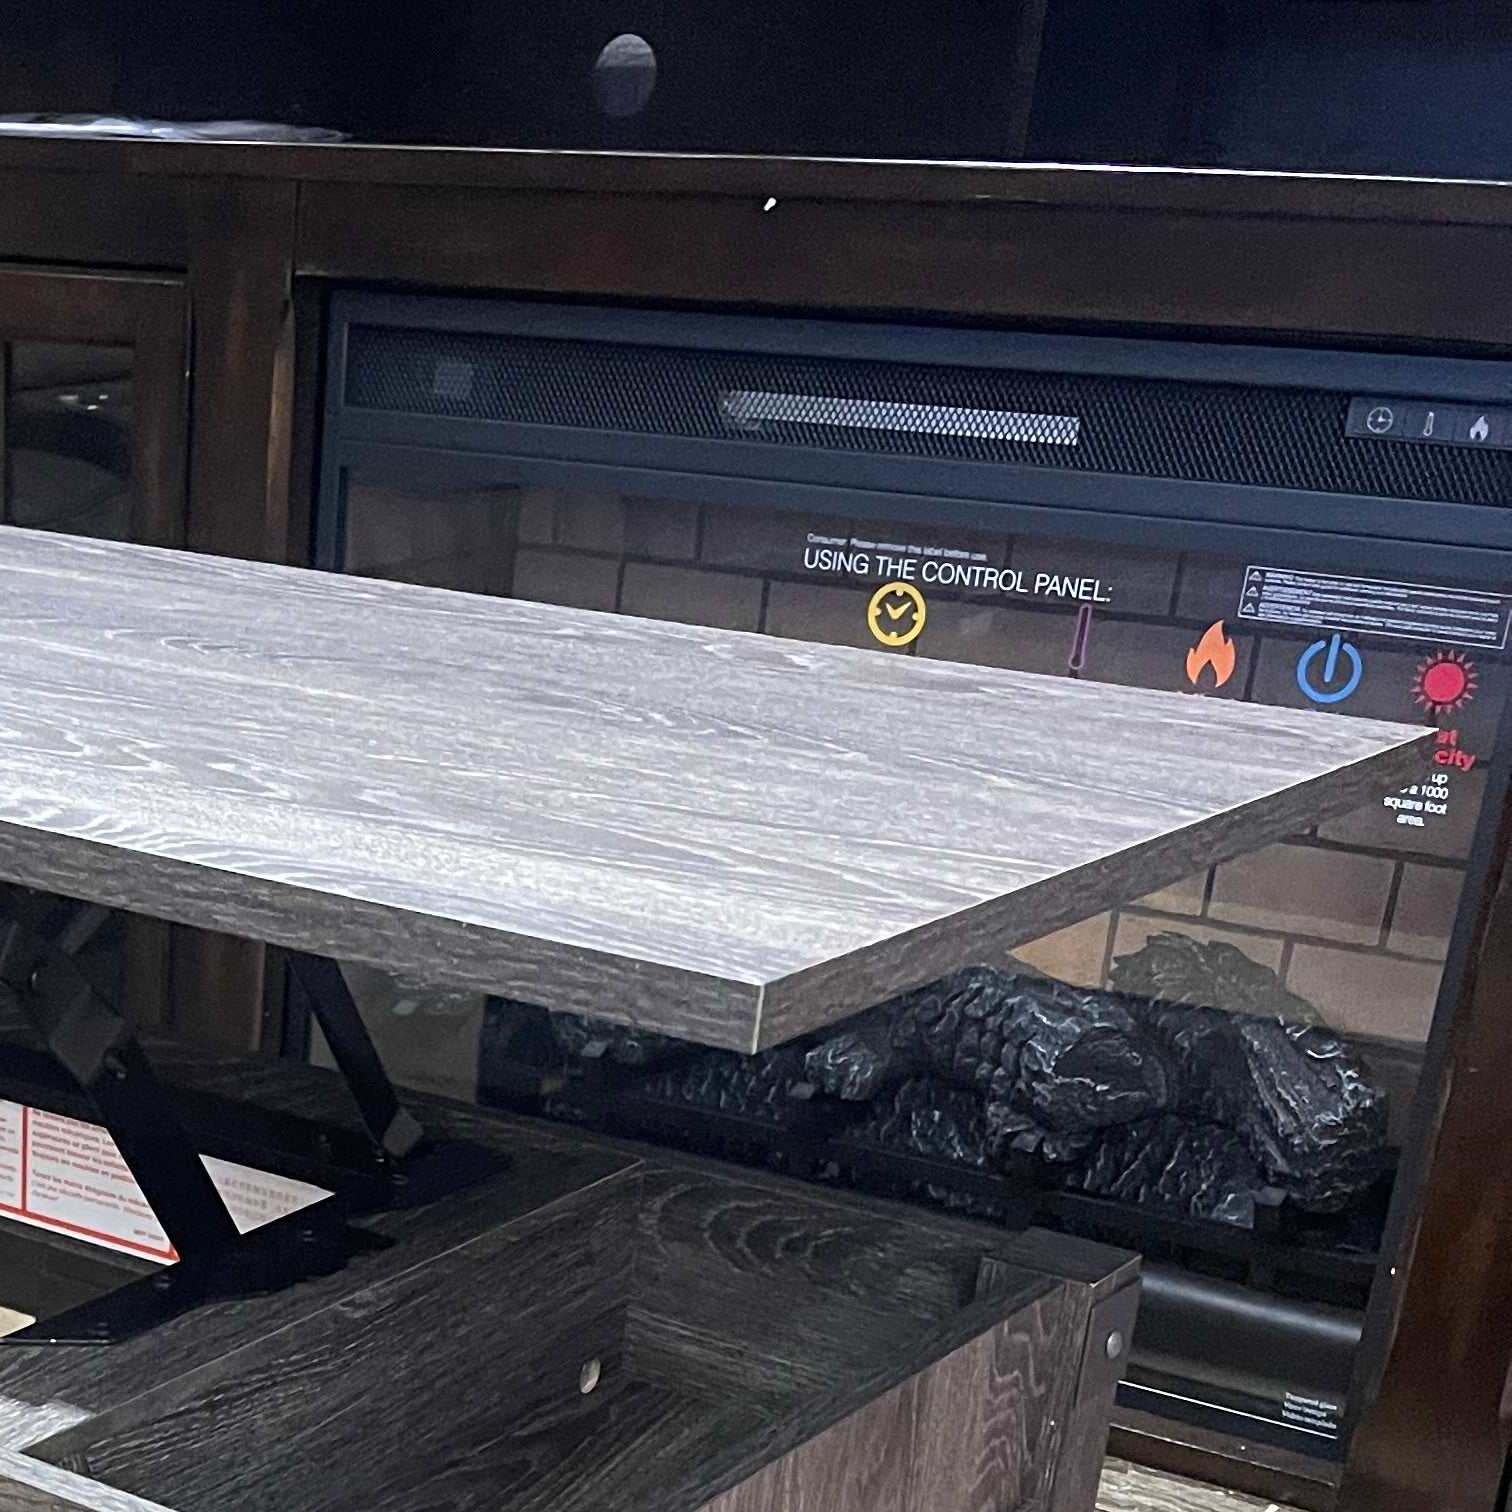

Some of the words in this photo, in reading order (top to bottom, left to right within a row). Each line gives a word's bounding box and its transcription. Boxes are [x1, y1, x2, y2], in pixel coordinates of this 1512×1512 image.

[804, 547, 870, 575] USING
[875, 555, 918, 581] THE
[921, 560, 1028, 593] CONTROL
[1034, 573, 1113, 603] PANEL:
[1435, 730, 1458, 746] at
[1434, 748, 1476, 772] city
[1431, 773, 1448, 786] up
[1421, 785, 1449, 800] 1000
[1383, 797, 1423, 811] square
[1424, 801, 1448, 815] foot
